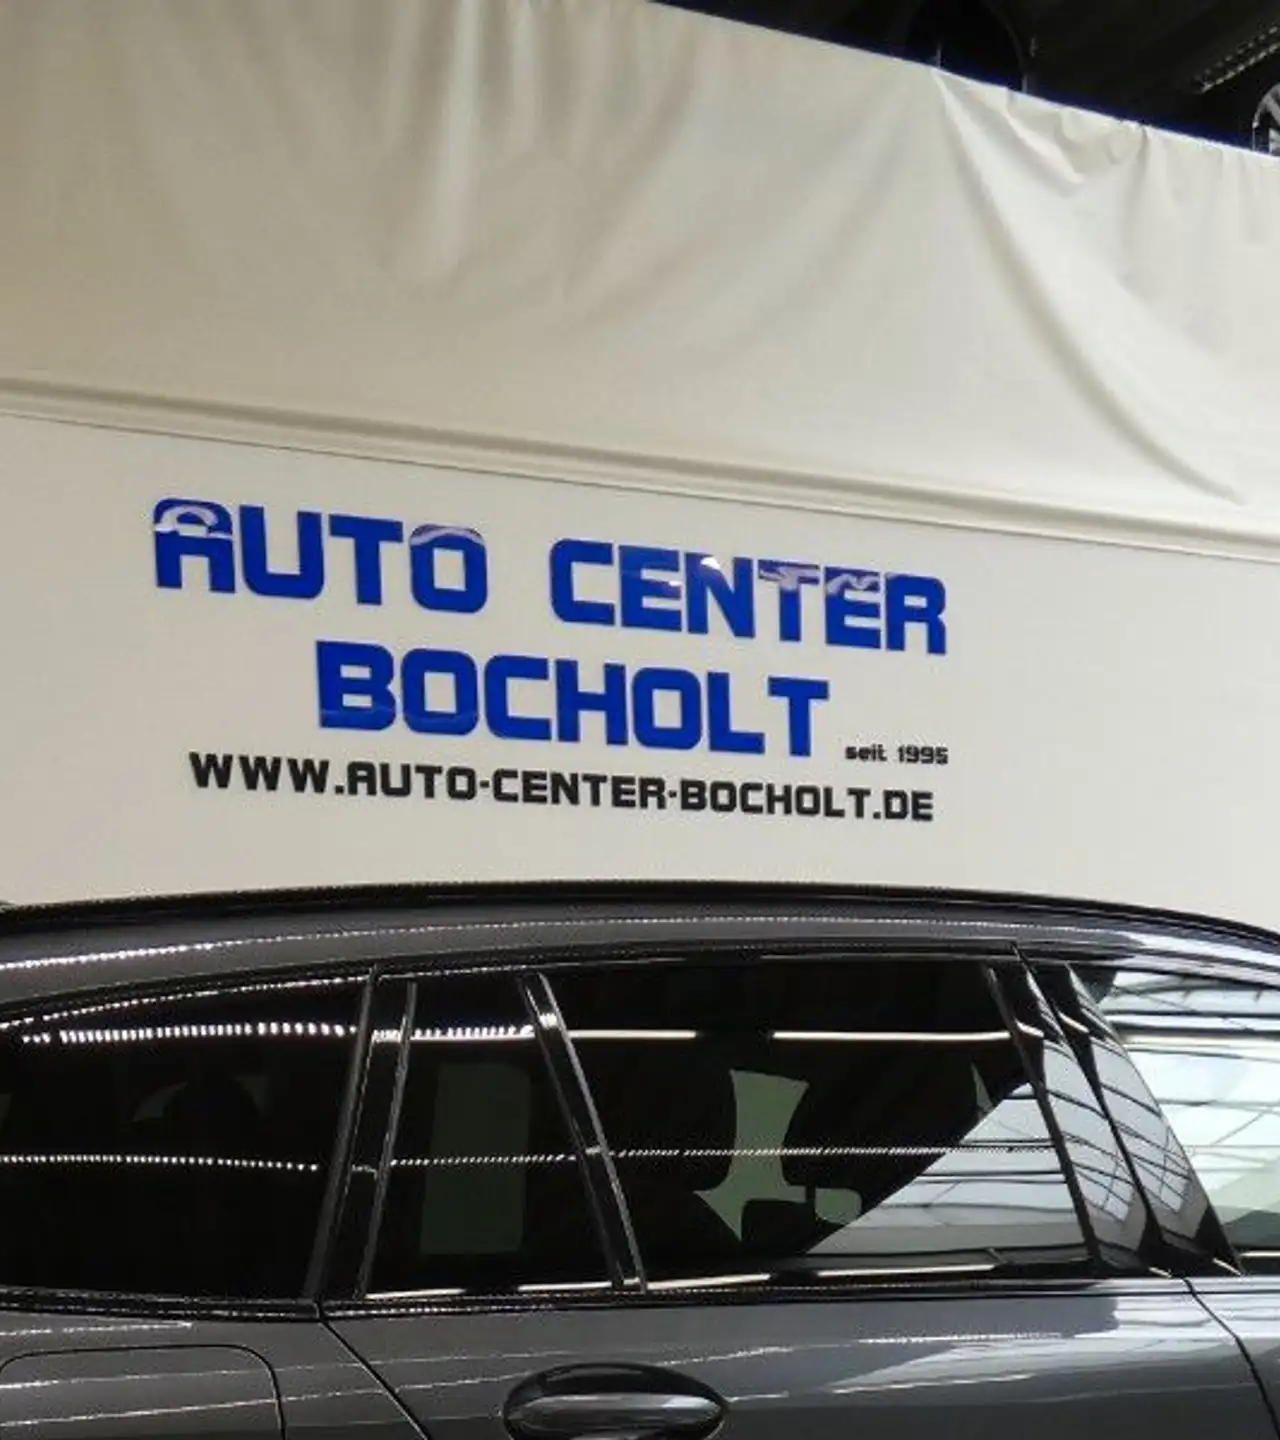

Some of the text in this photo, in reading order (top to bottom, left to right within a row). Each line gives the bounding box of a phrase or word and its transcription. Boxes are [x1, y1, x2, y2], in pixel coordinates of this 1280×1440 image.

[152, 498, 947, 655] AUTO CENTER
[315, 640, 830, 757] BOCHOLT
[189, 751, 934, 822] WWW.AUTO-CENTER-BOCHOLT.DE
[845, 744, 949, 765] seit 1995
